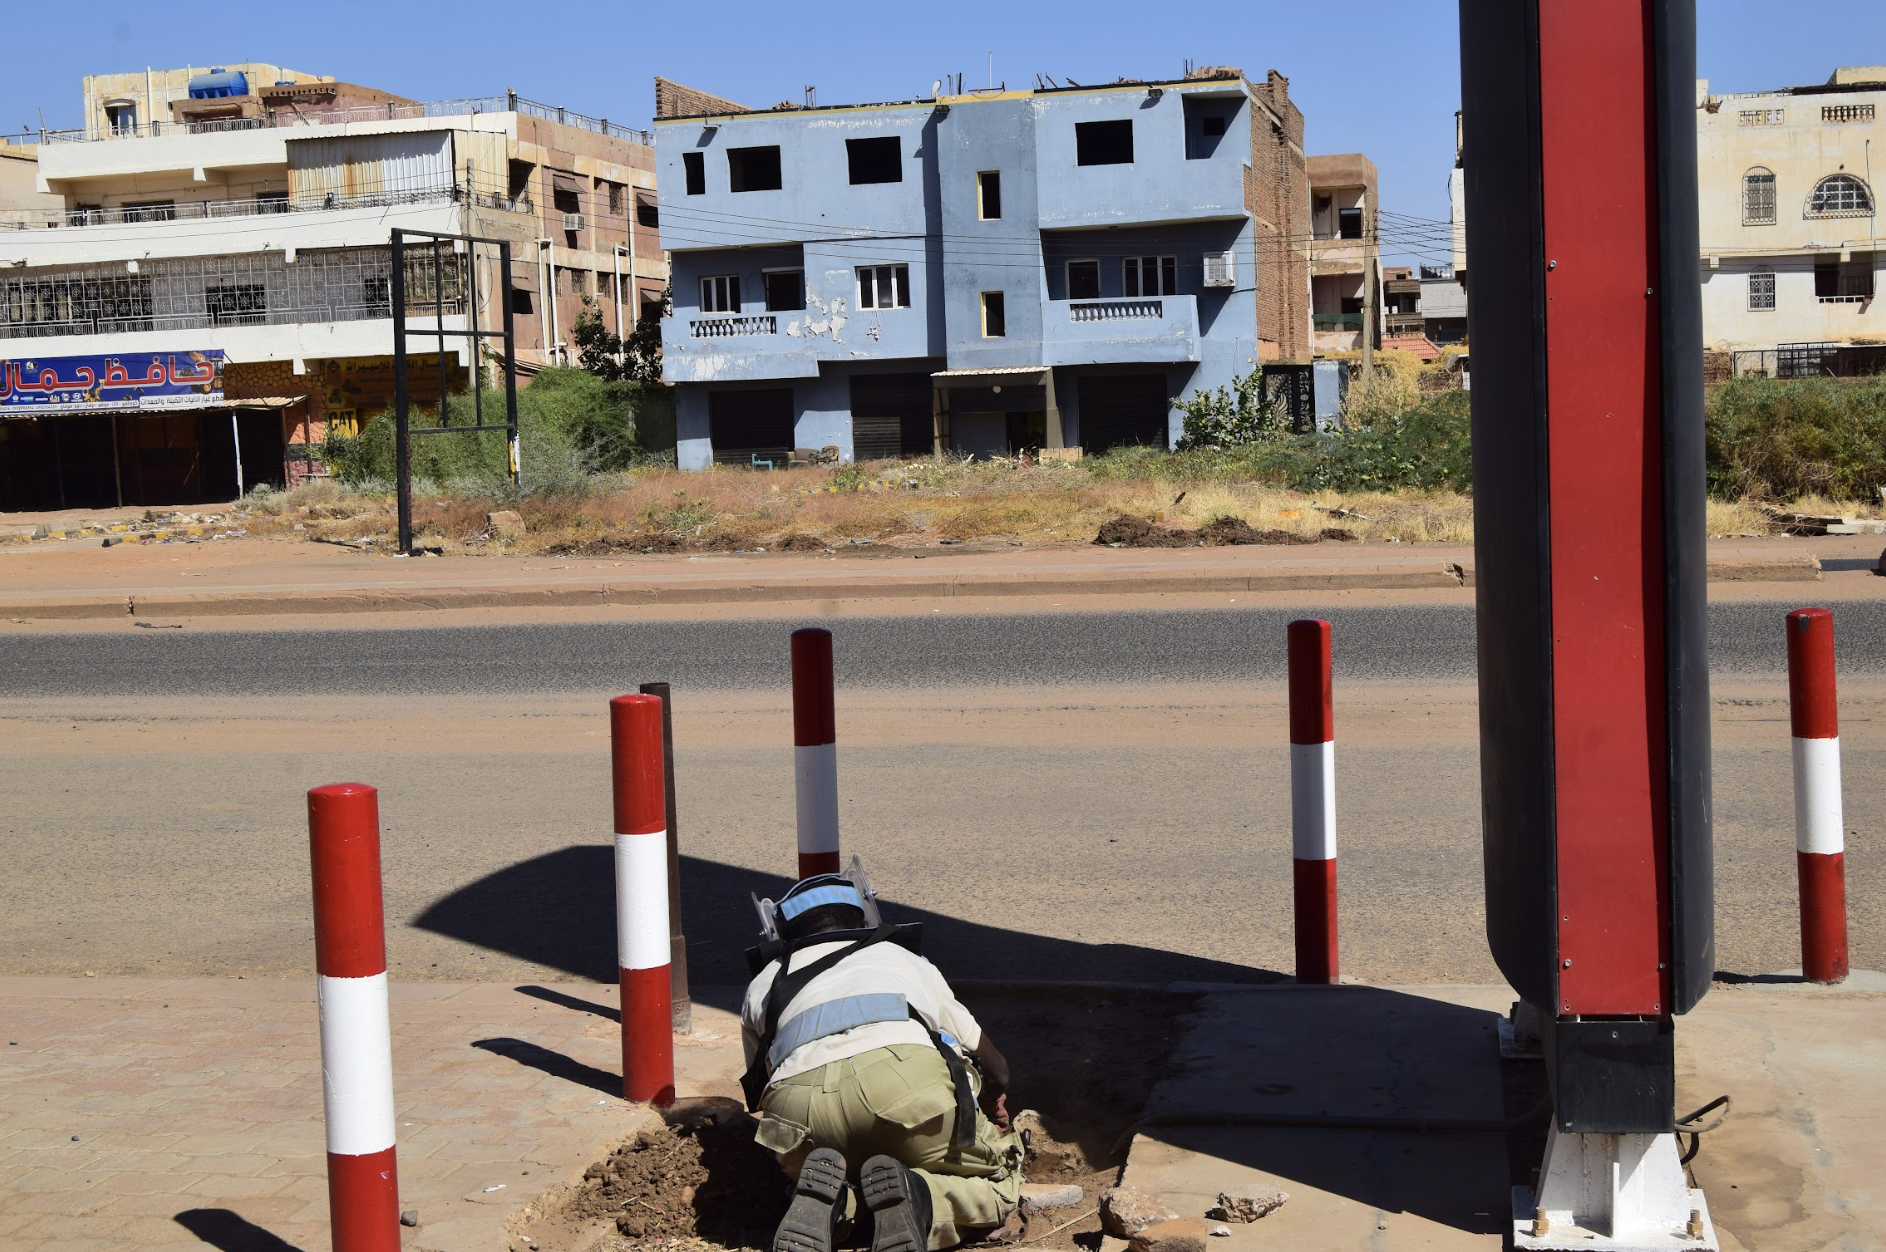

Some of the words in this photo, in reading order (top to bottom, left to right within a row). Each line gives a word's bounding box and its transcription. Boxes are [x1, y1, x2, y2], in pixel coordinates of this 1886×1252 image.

[0, 362, 95, 400] جمال
[103, 356, 214, 389] حافظ
[329, 410, 354, 431] CAT
